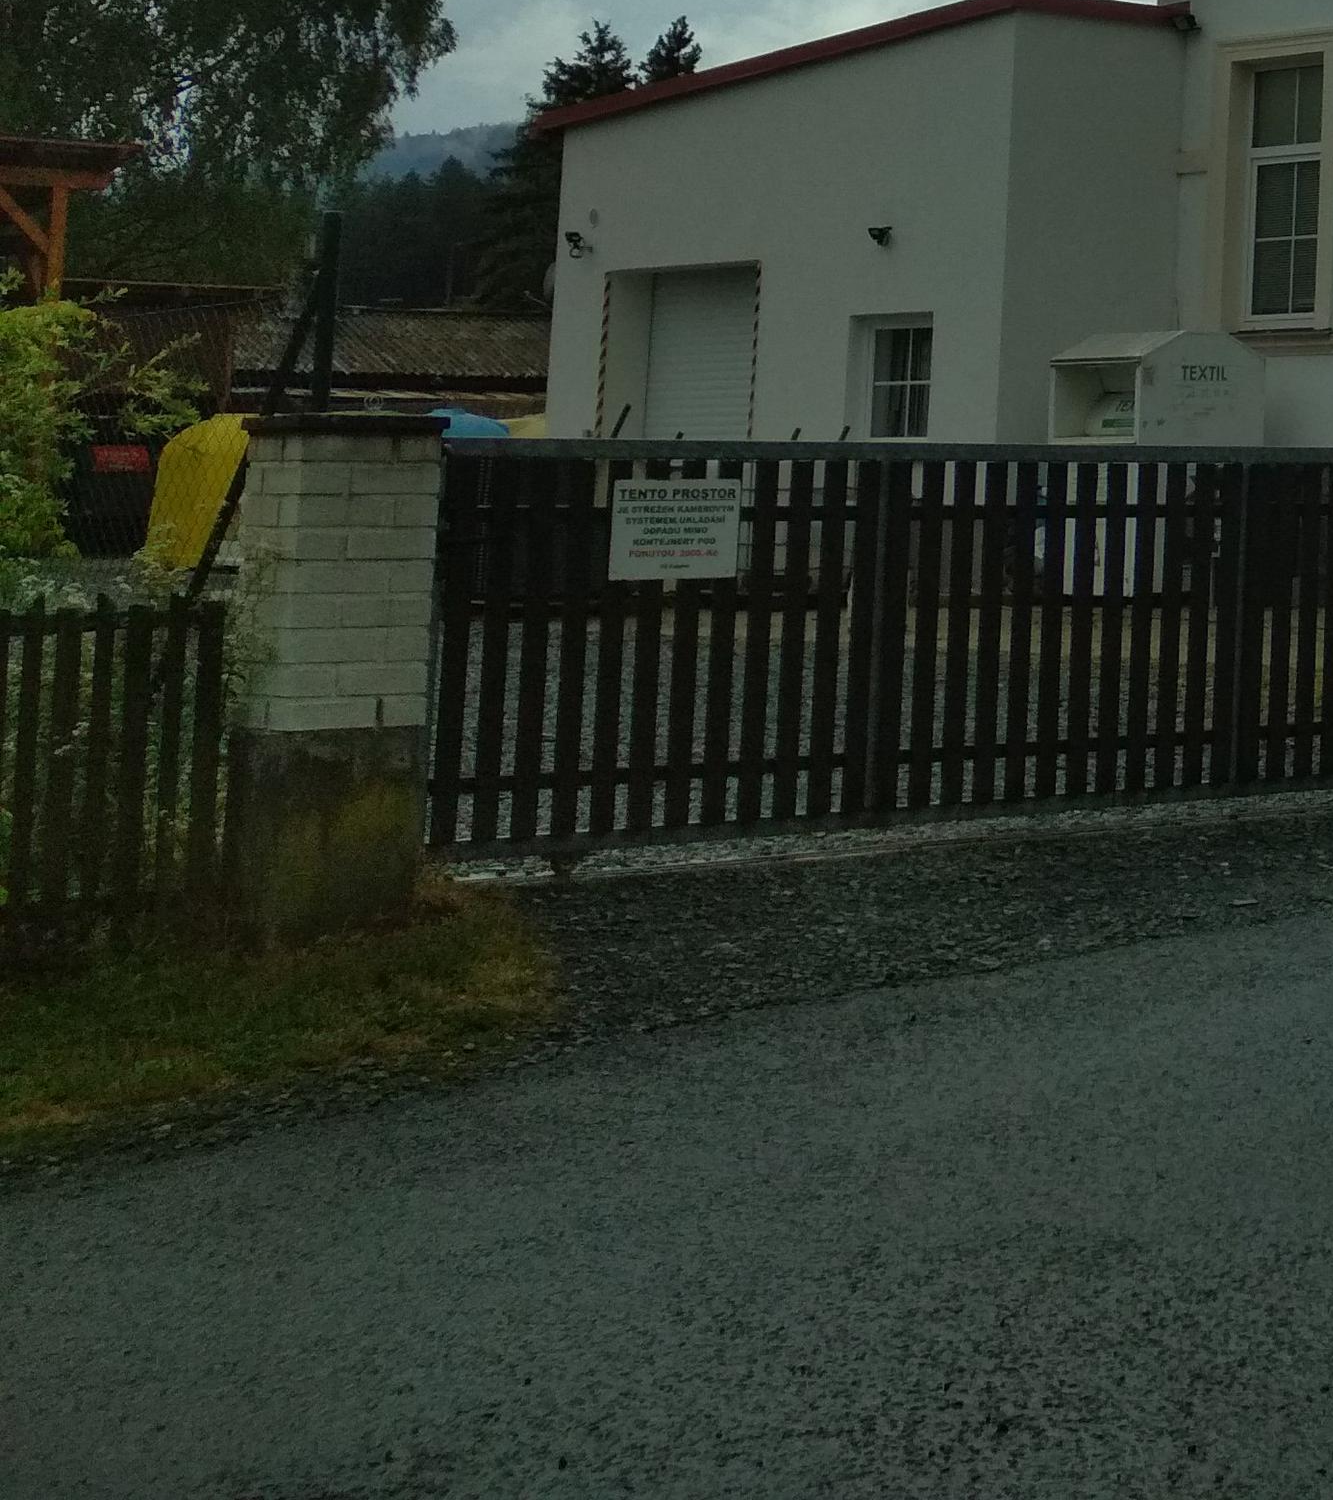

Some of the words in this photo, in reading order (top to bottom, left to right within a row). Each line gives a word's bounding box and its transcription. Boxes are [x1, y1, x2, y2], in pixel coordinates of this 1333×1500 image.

[1181, 364, 1228, 382] TEXTIL
[619, 488, 668, 499] TENTO
[672, 488, 737, 499] PROSTOR
